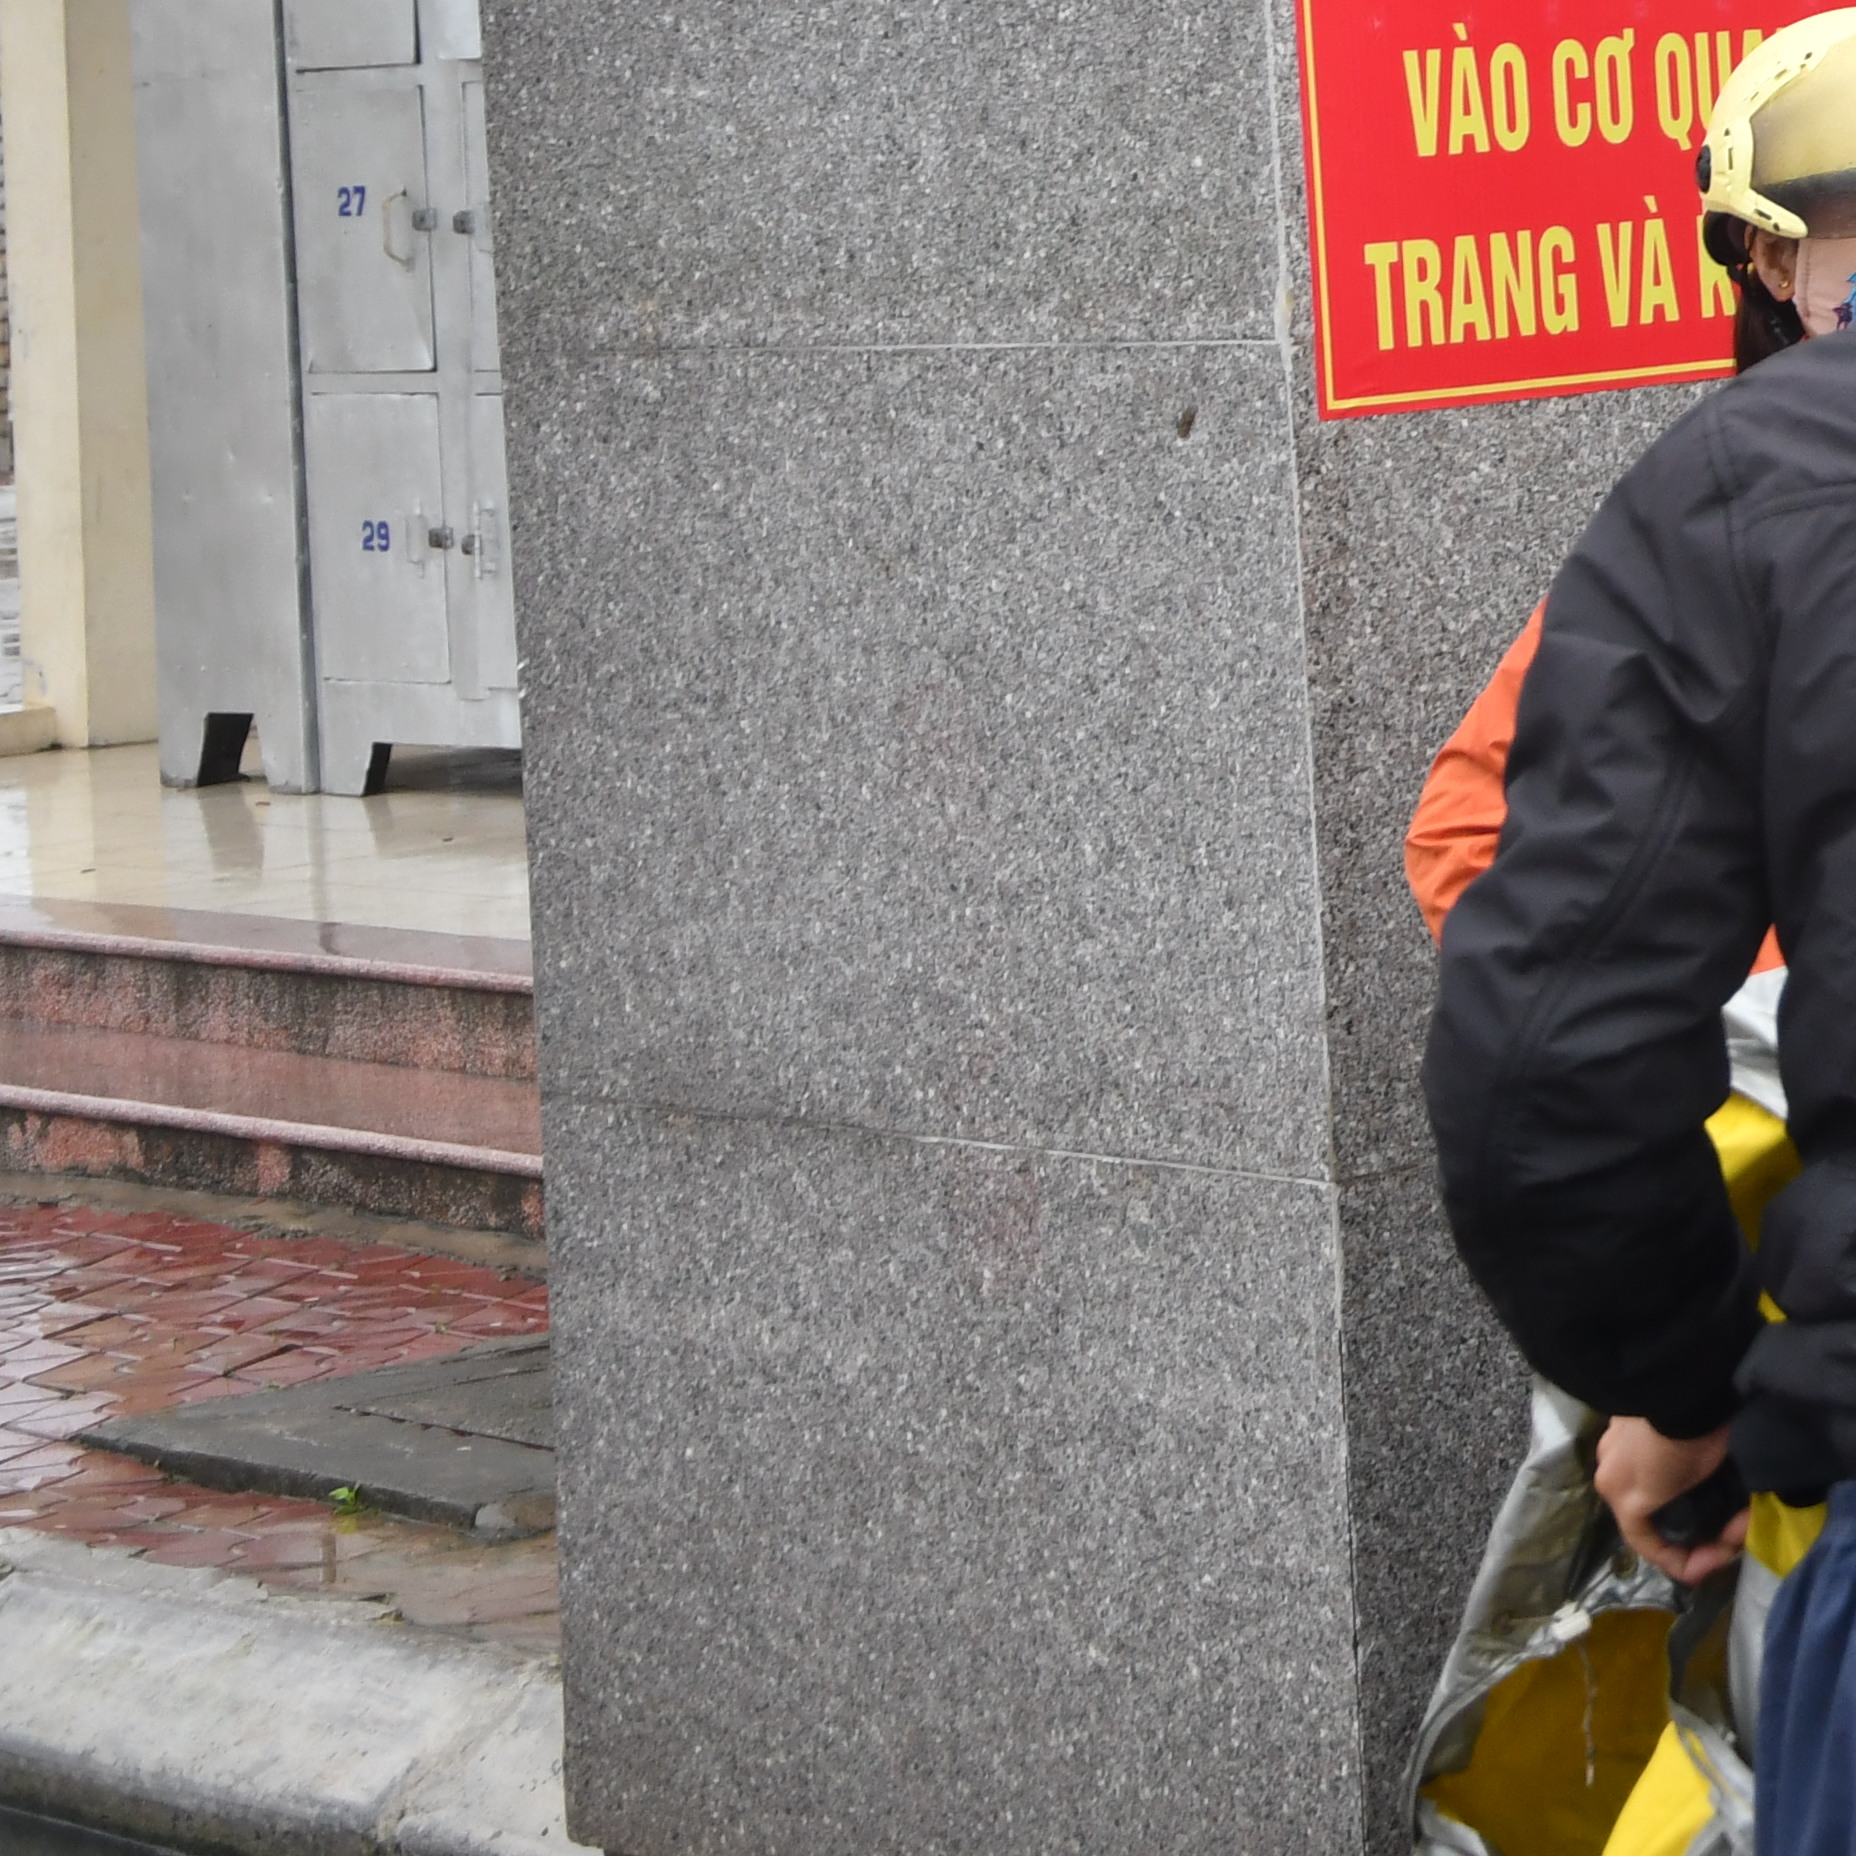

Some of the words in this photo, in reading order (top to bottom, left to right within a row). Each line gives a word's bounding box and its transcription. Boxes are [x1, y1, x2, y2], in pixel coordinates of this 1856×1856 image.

[1401, 21, 1531, 158] VÀO
[1551, 25, 1636, 149] CƠ
[1653, 28, 1770, 152] QU
[337, 183, 368, 219] 27
[1363, 227, 1580, 353] TRANG
[1595, 193, 1682, 329] VÀ
[361, 518, 392, 554] 29
